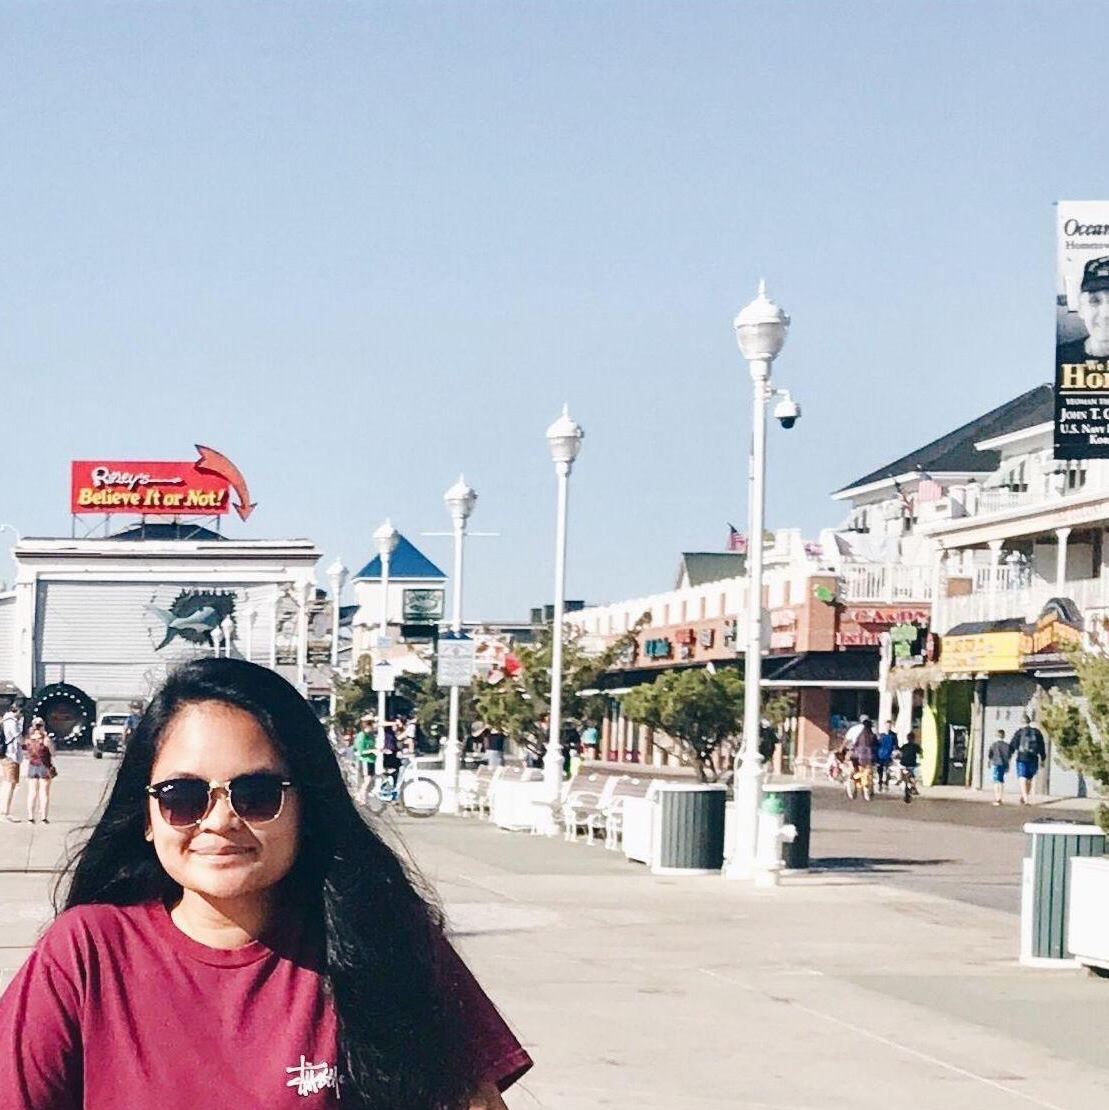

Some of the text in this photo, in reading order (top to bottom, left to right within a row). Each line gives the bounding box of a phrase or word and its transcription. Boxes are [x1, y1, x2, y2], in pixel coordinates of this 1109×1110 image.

[78, 488, 225, 506] Believe It or Not!
